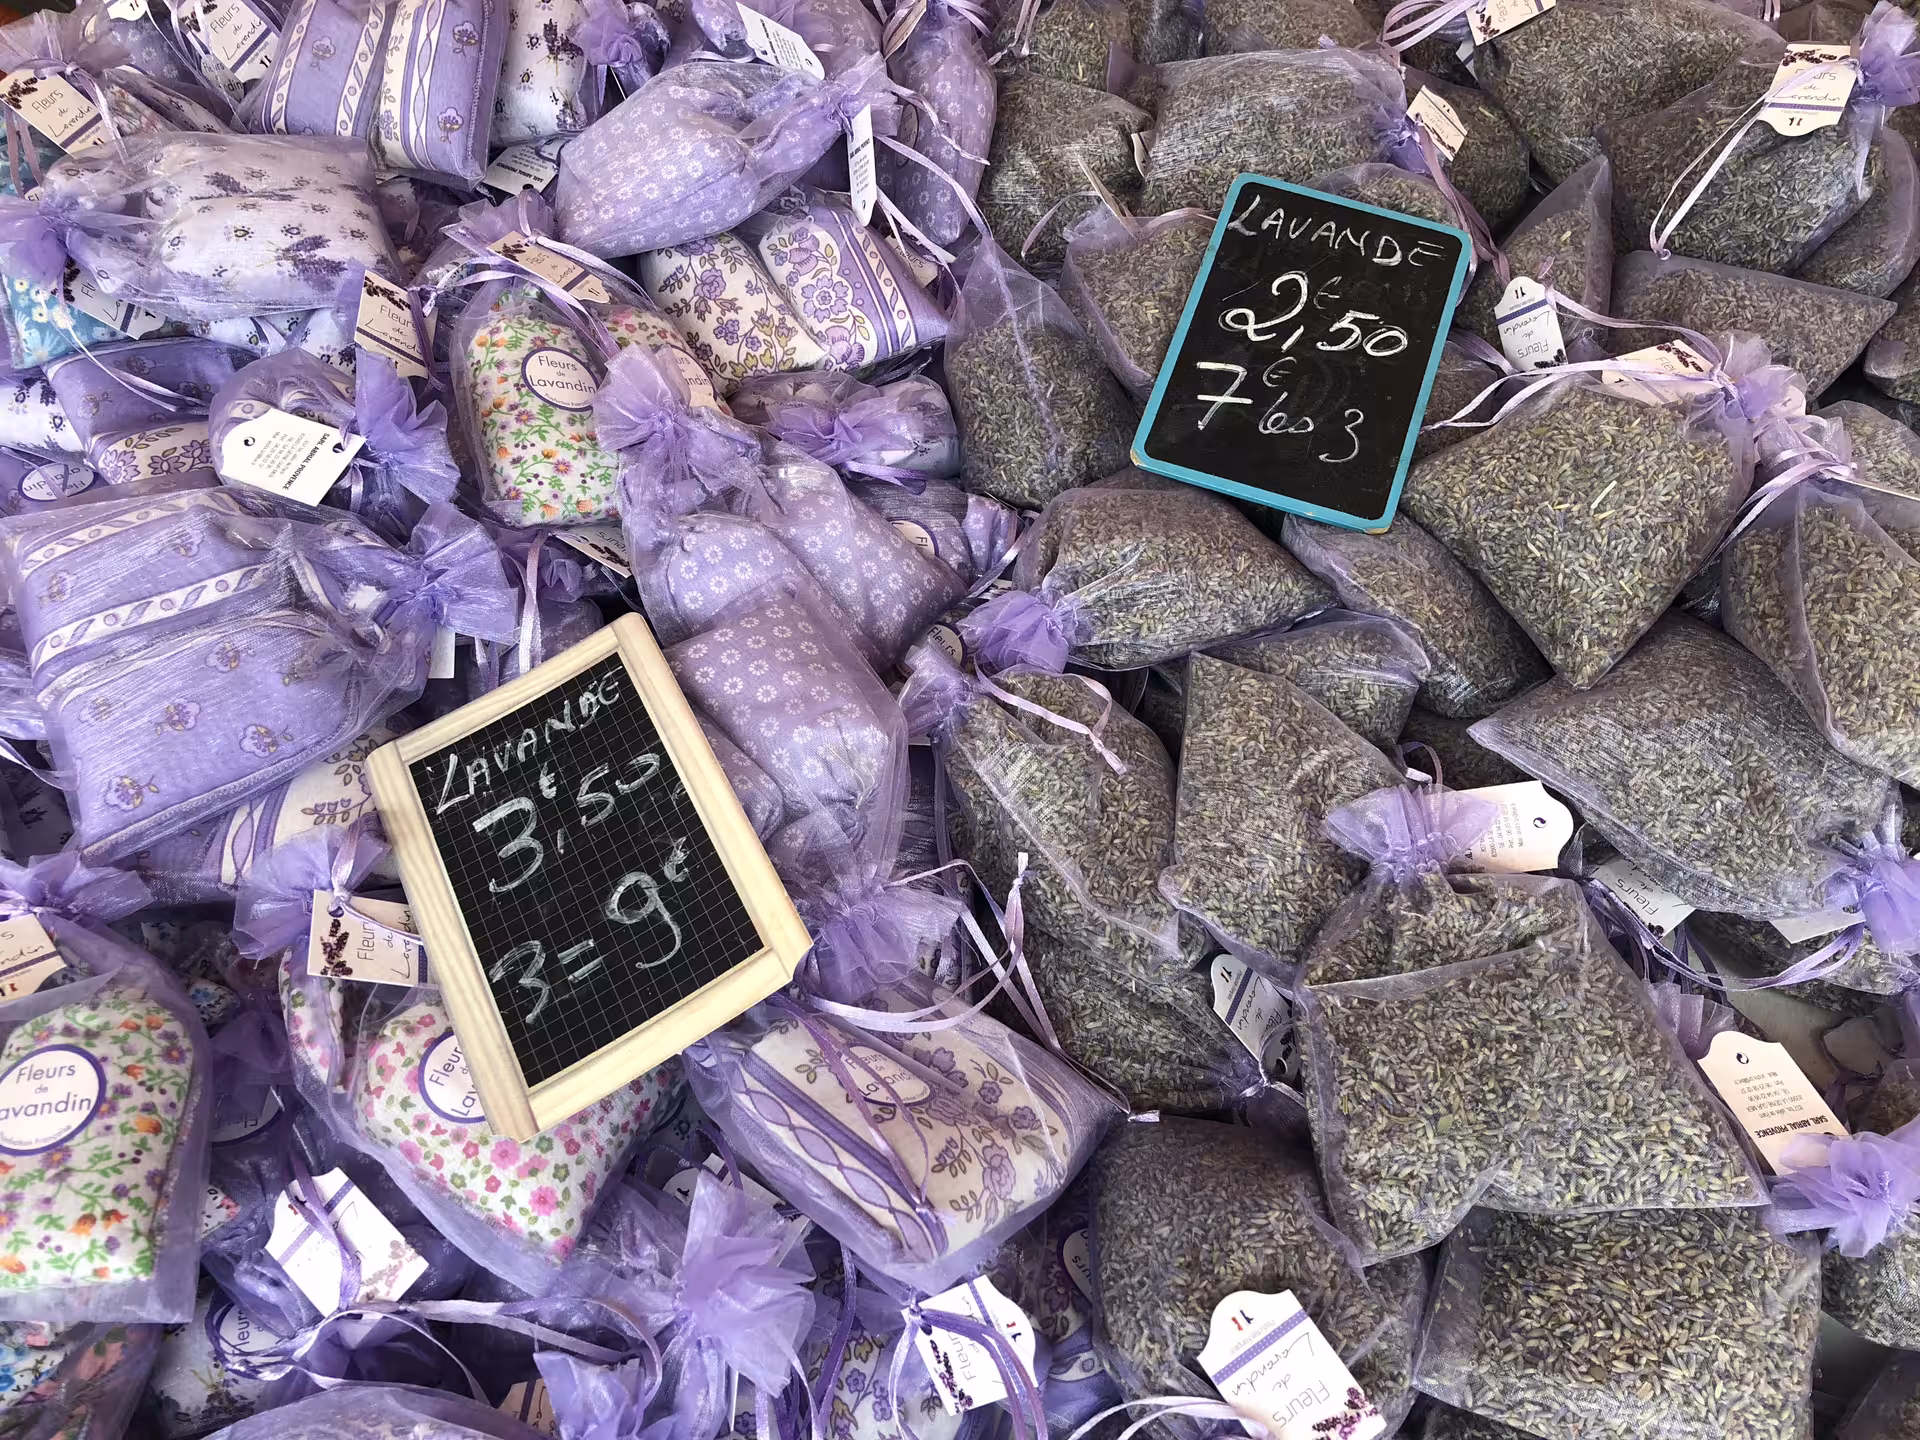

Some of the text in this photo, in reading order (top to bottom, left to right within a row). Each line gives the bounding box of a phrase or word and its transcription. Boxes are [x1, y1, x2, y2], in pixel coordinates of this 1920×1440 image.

[210, 3, 240, 34] Fleurs
[232, 23, 243, 36] de
[222, 19, 262, 61] Lavandi
[1803, 83, 1822, 91] de
[31, 89, 64, 114] Fleurs
[58, 107, 68, 117] de
[48, 105, 92, 138] Lavandin
[1227, 194, 1447, 268] LAVANDE
[364, 318, 423, 355] Lavandi
[391, 326, 408, 337] de
[1503, 310, 1550, 337] Lavandin
[1521, 329, 1535, 341] de
[1517, 339, 1550, 360] Fleurs
[538, 355, 578, 372] Fleurs
[556, 369, 566, 377] de
[529, 374, 597, 395] Lavandin
[1318, 408, 1365, 464] 3
[435, 665, 624, 816] LAVANDE
[1614, 878, 1660, 917] Fleurs
[1636, 879, 1654, 893] de
[355, 920, 376, 962] Fleur
[383, 931, 395, 949] de
[390, 908, 413, 979] Lavadin
[16, 1062, 77, 1084] Fleurs
[428, 1045, 464, 1087] Fleur
[34, 1083, 49, 1095] de
[0, 1091, 92, 1122] avandin
[1754, 1114, 1829, 1139] SARL ABRIAL PROVENCE
[948, 1333, 977, 1382] Fleur
[1231, 1331, 1315, 1397] Lavandin
[1271, 1372, 1292, 1392] de
[1271, 1379, 1331, 1429] Fleurs
